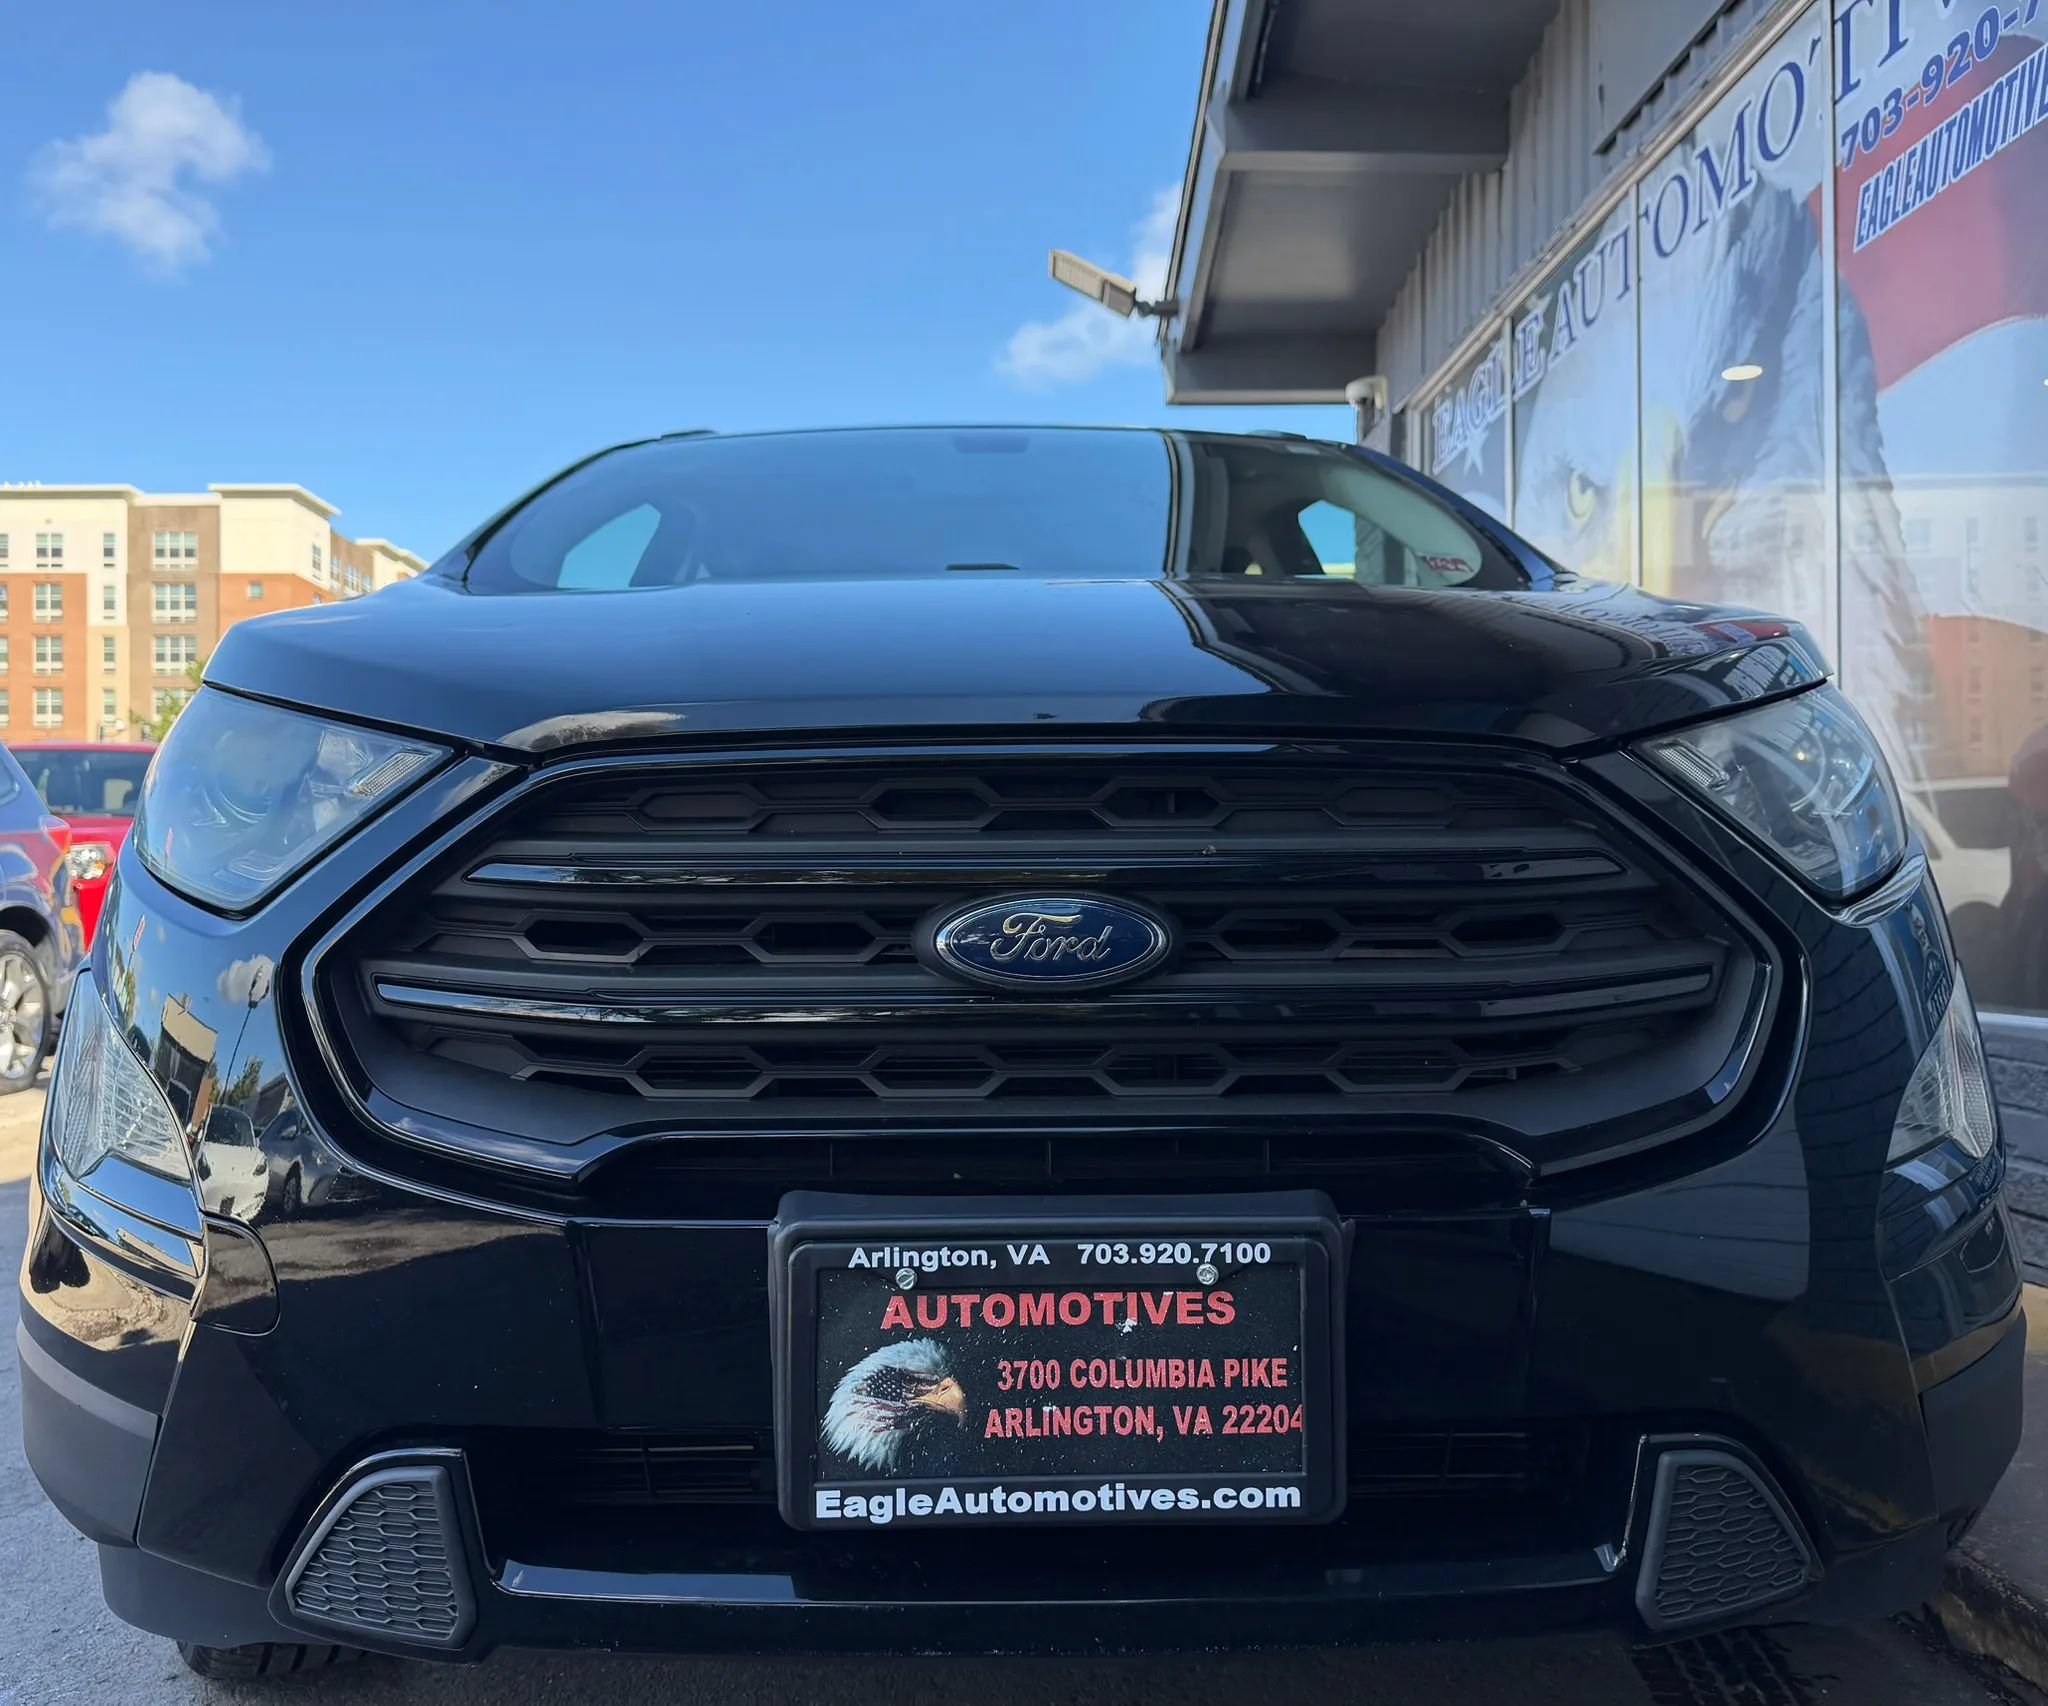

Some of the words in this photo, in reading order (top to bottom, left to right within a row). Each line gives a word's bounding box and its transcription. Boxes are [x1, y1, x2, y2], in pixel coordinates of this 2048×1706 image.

[1548, 0, 1957, 366] AUTOMOTI
[990, 912, 1113, 961] Ford
[848, 1246, 997, 1272] Arlington,
[1006, 1243, 1051, 1265] VA
[1077, 1242, 1272, 1265] 703.920.7100
[879, 1290, 1237, 1331] AUTOMOTIVES
[997, 1358, 1061, 1390] 3700
[1069, 1357, 1216, 1389] COLUMBIA
[1224, 1357, 1288, 1388] PIKE
[984, 1404, 1165, 1441] ARLINGTON,
[1172, 1405, 1214, 1436] VA
[1221, 1403, 1303, 1435] 22204
[814, 1483, 1302, 1525] EagleAutomotives.com
